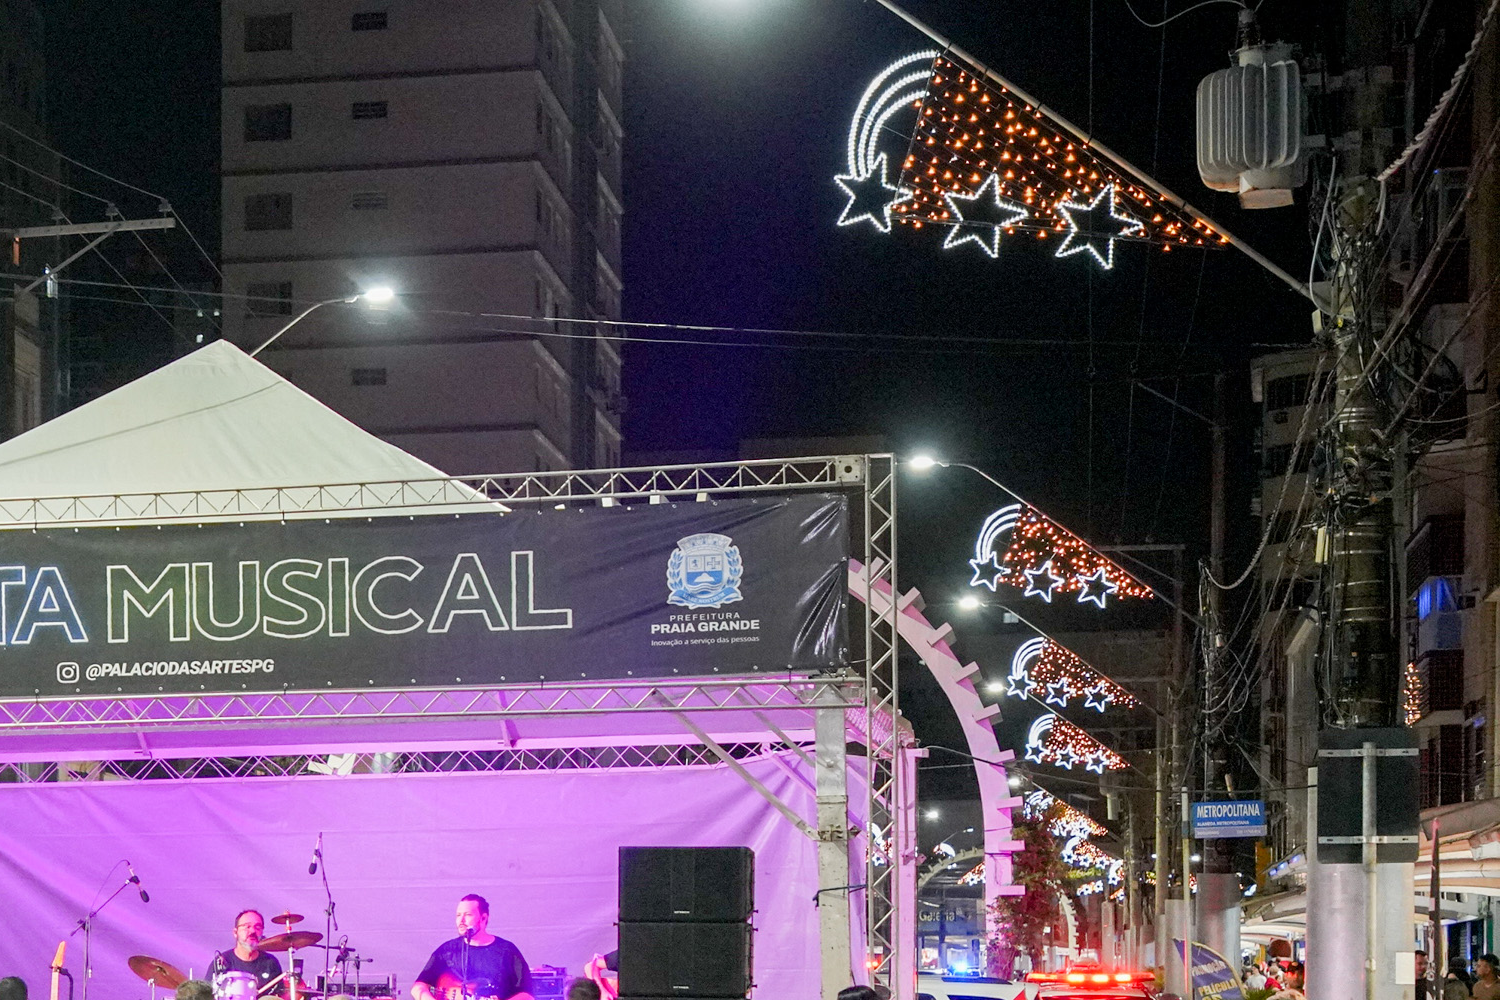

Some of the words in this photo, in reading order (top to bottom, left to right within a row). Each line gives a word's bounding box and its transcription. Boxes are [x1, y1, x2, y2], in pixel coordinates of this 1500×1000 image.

[106, 550, 573, 643] MUSICAL
[670, 612, 740, 622] PREFEITURA
[651, 622, 695, 634] PRAIA
[698, 620, 760, 631] GRANDE
[651, 639, 683, 647] Inovação
[730, 636, 760, 644] pessoas
[86, 658, 275, 681] @PALACIODASARTESPG
[1197, 803, 1261, 818] METROPOLITANA
